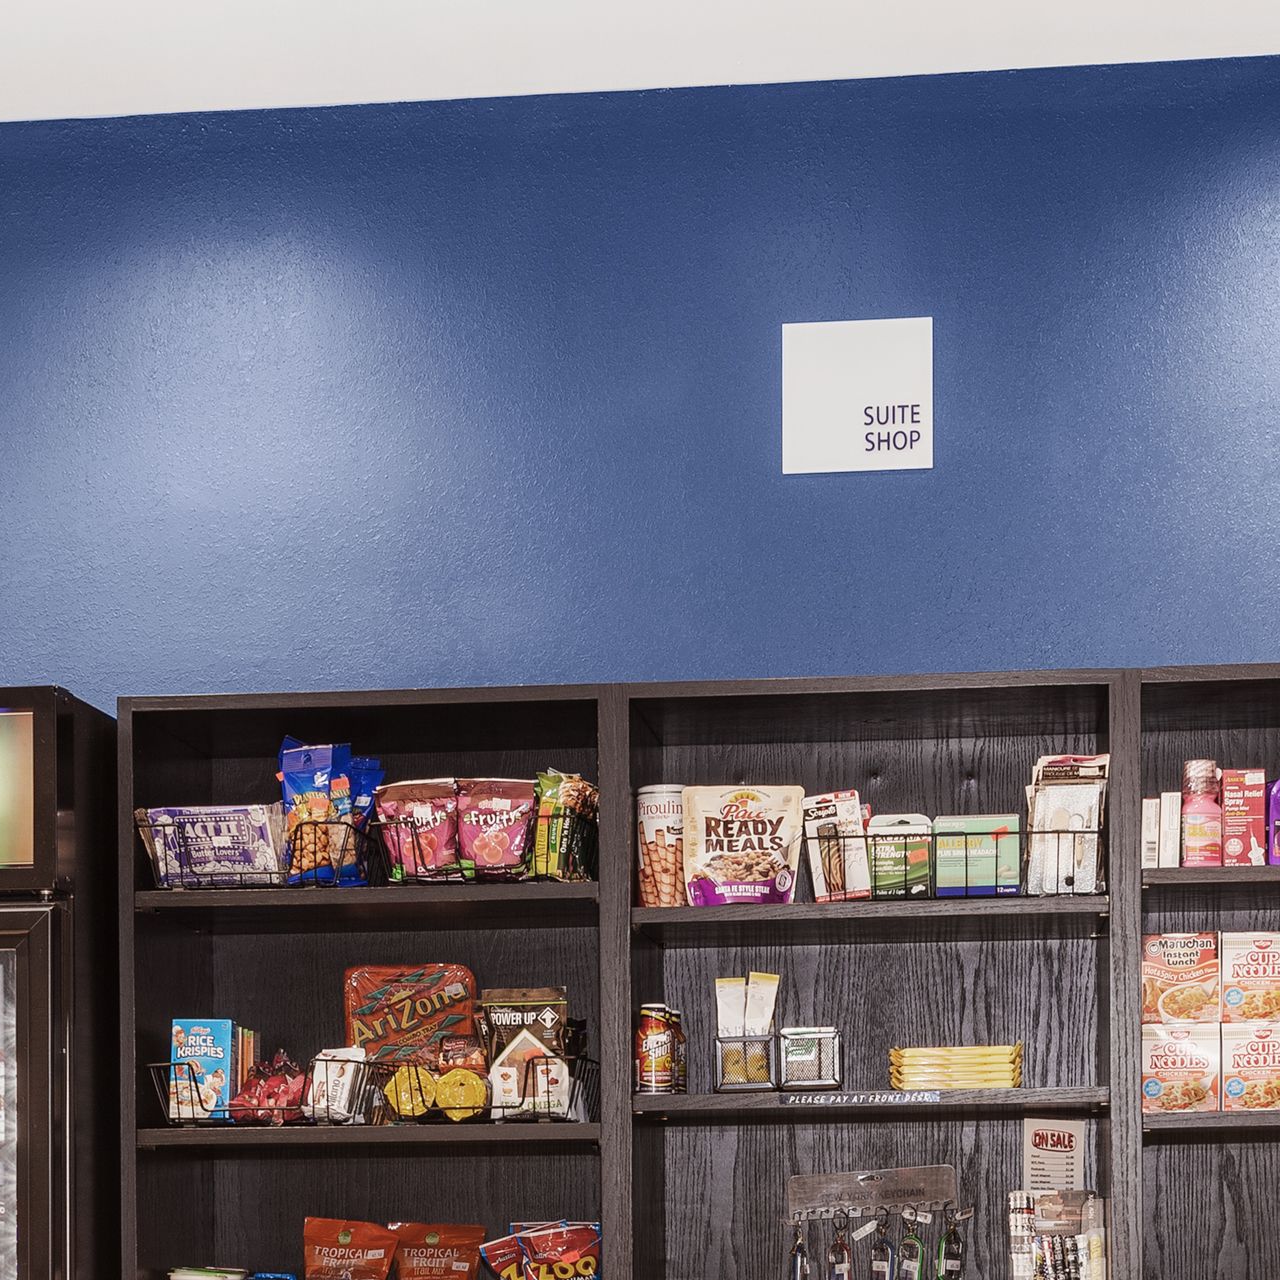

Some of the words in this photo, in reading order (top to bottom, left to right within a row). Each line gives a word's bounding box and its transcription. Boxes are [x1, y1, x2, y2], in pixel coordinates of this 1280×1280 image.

[864, 404, 920, 425] SUITE
[865, 430, 920, 451] SHOP
[1224, 790, 1243, 798] Nasal
[1244, 790, 1263, 798] Relief
[1224, 798, 1244, 807] Spray
[705, 816, 785, 838] READY
[705, 836, 784, 853] MEALS
[1158, 939, 1212, 949] Maruchan
[1163, 950, 1199, 958] Instant
[1246, 951, 1280, 965] CUP
[1167, 958, 1196, 966] Lunch
[491, 1012, 522, 1026] POWER
[524, 1012, 536, 1025] UP
[188, 1035, 214, 1047] RICE
[177, 1047, 224, 1059] KRISPIES
[1246, 1042, 1280, 1055] CUP
[1150, 1055, 1209, 1069] NOODLES
[790, 1094, 825, 1104] PLEASE
[830, 1094, 848, 1103] PAY
[852, 1093, 864, 1102] AT
[870, 1092, 901, 1102] FRONT
[1034, 1133, 1048, 1147] ON
[1050, 1133, 1073, 1149] SALE
[315, 1246, 370, 1259] TROPICAL
[403, 1247, 460, 1258] TROPICAL
[413, 1257, 447, 1268] FRUIT
